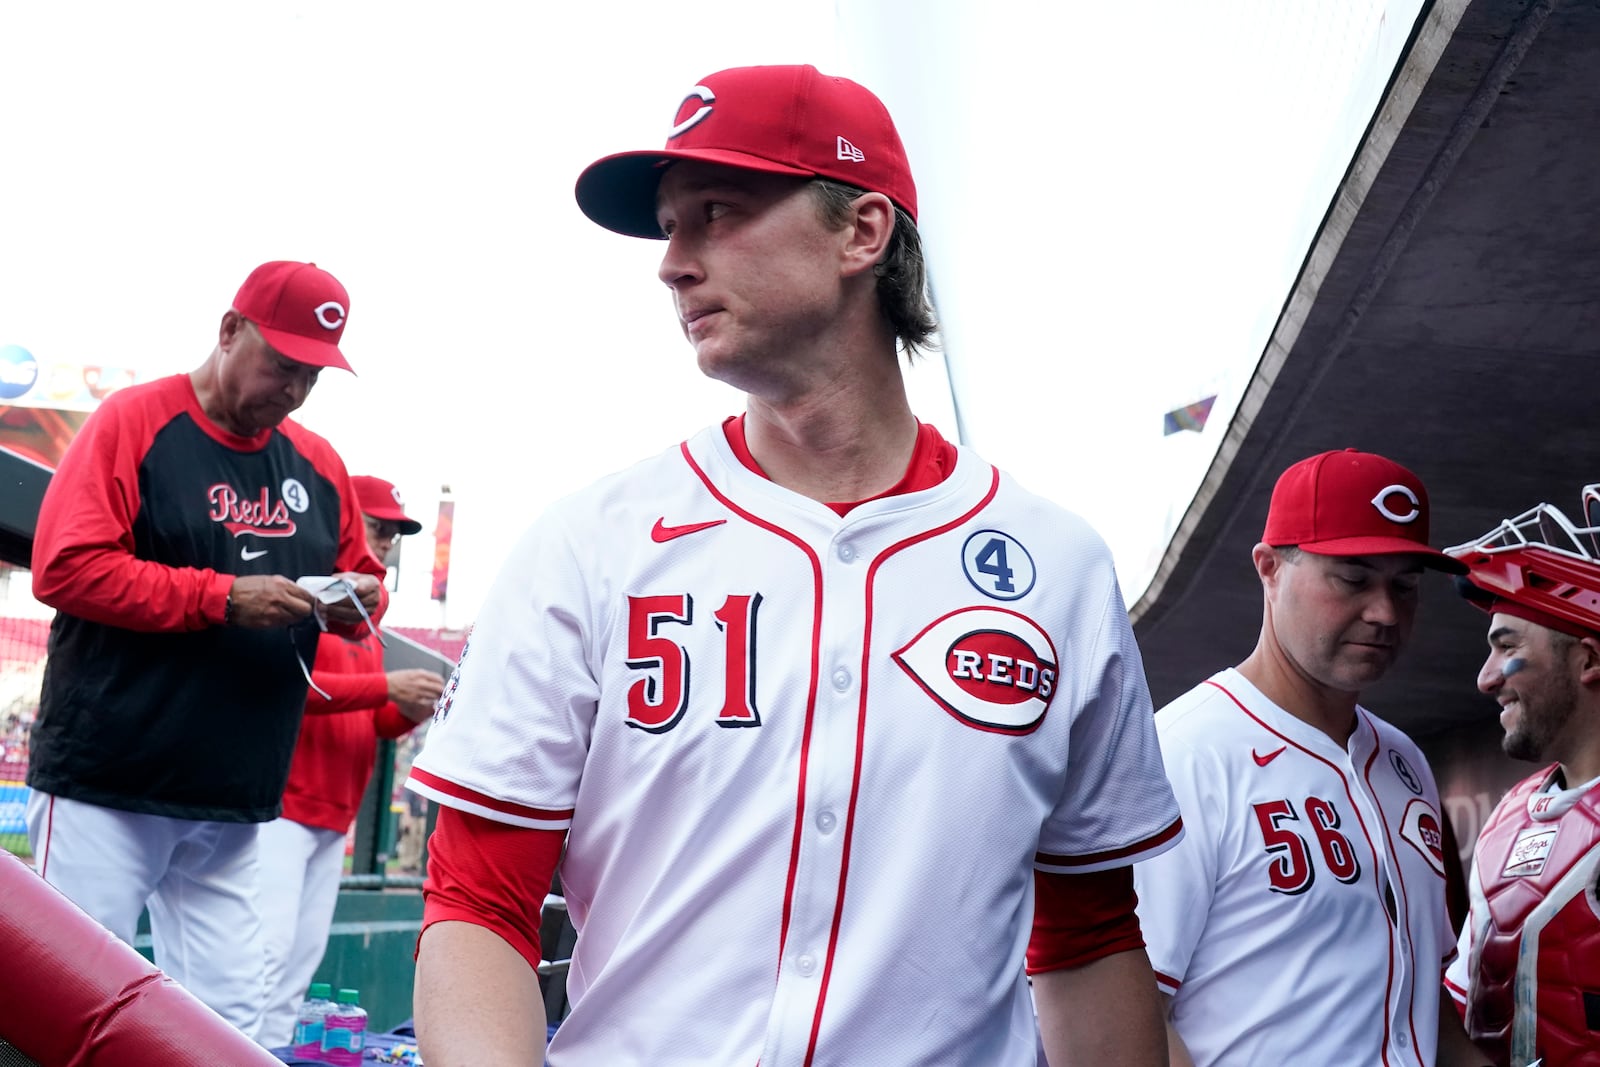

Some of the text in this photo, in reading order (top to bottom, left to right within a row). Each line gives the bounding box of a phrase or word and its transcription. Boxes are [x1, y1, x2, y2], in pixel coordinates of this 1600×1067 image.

[314, 301, 345, 330] C
[208, 482, 291, 527] Reds
[288, 483, 301, 508] 4
[1371, 484, 1420, 524] C
[975, 537, 1014, 593] 4
[624, 592, 763, 735] 51
[951, 648, 1057, 700] REDS
[1252, 796, 1362, 896] 56
